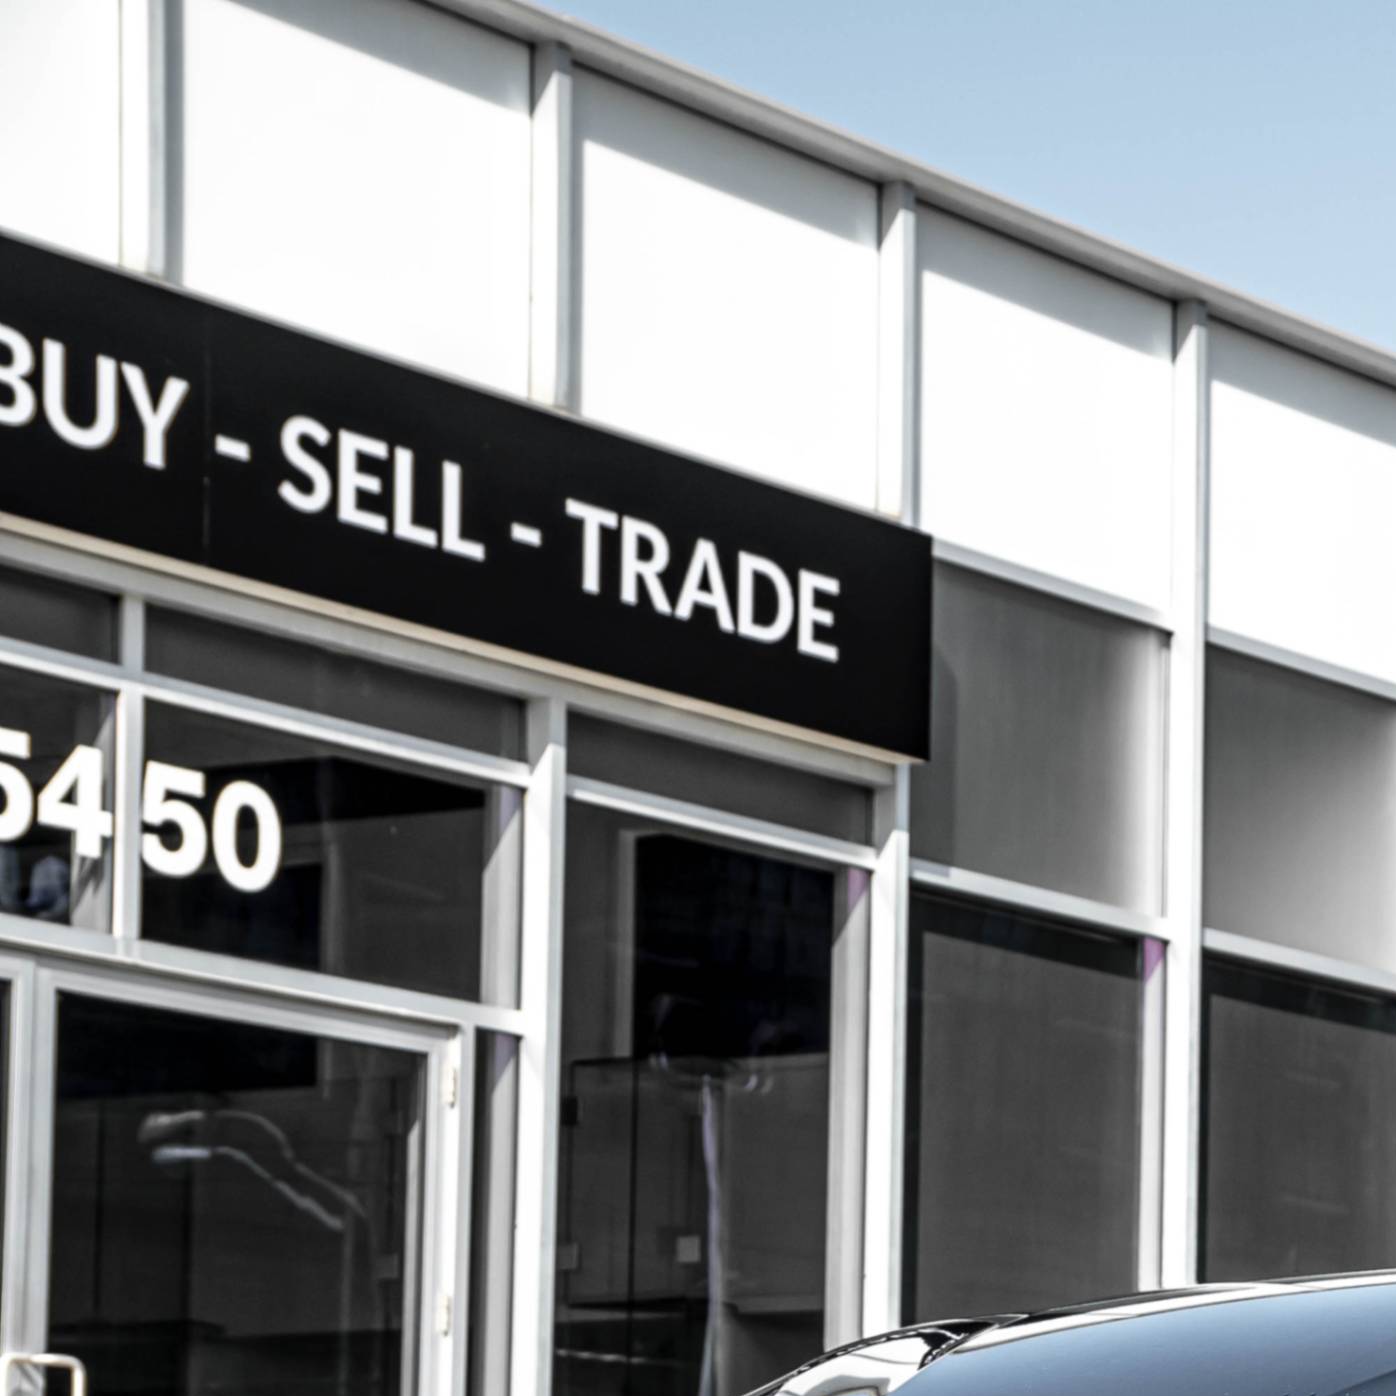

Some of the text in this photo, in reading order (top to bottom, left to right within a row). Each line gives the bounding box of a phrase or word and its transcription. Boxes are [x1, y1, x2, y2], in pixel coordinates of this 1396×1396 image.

[0, 322, 190, 470] BUY
[277, 415, 486, 562] SELL
[564, 497, 841, 664] TRADE
